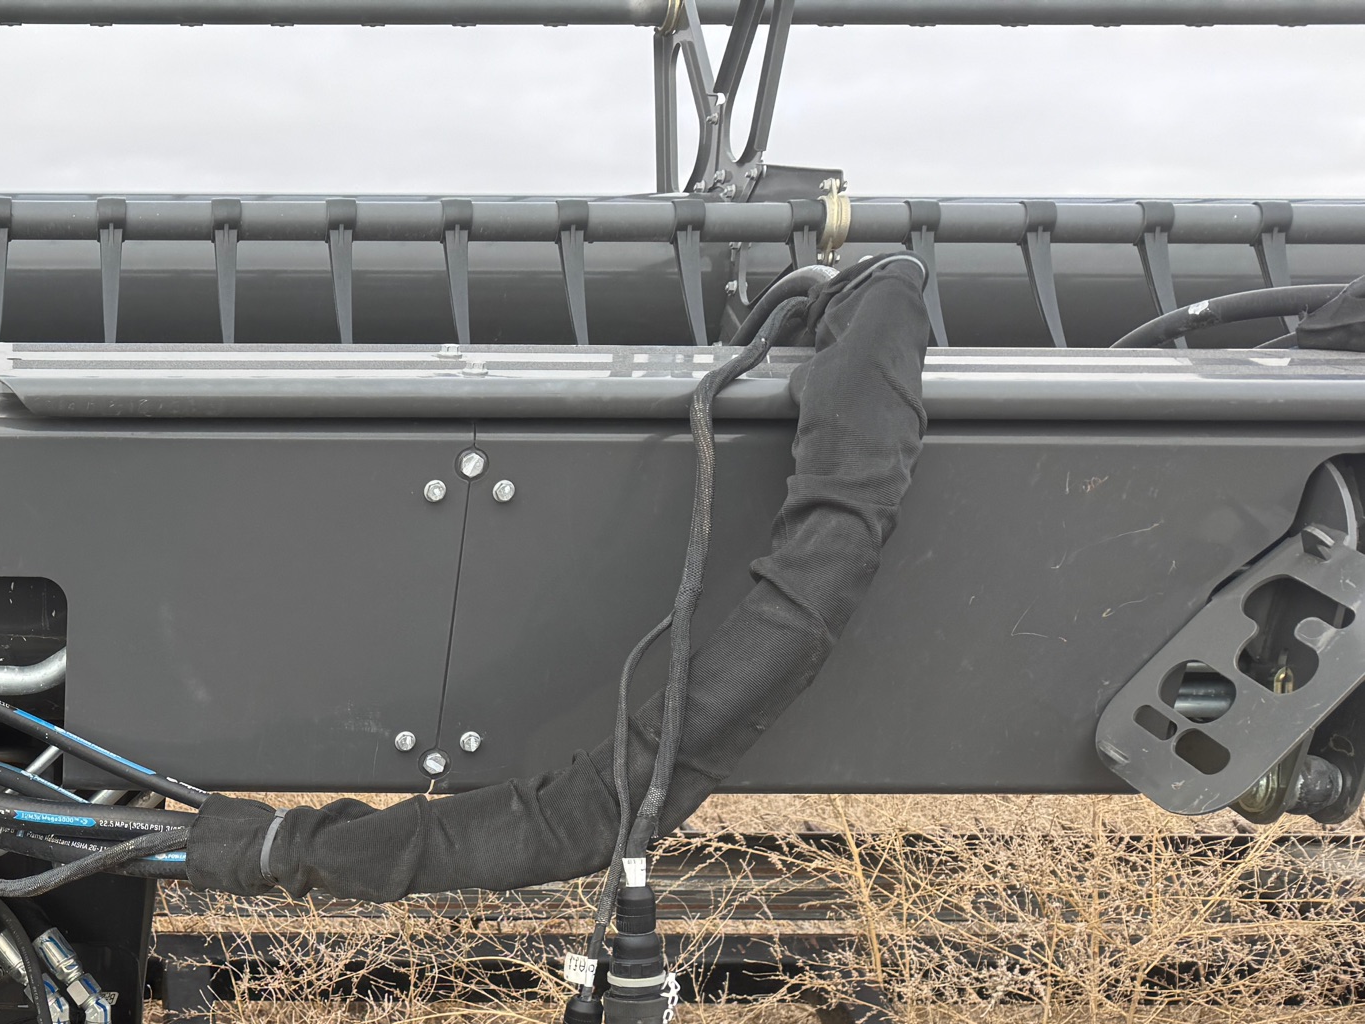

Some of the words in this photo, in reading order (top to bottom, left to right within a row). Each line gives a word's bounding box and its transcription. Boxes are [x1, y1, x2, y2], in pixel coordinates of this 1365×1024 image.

[99, 819, 114, 828] 22.5
[115, 821, 128, 829] MPa
[26, 831, 44, 840] Flame
[44, 834, 71, 846] Resistant
[71, 840, 88, 850] MSHA
